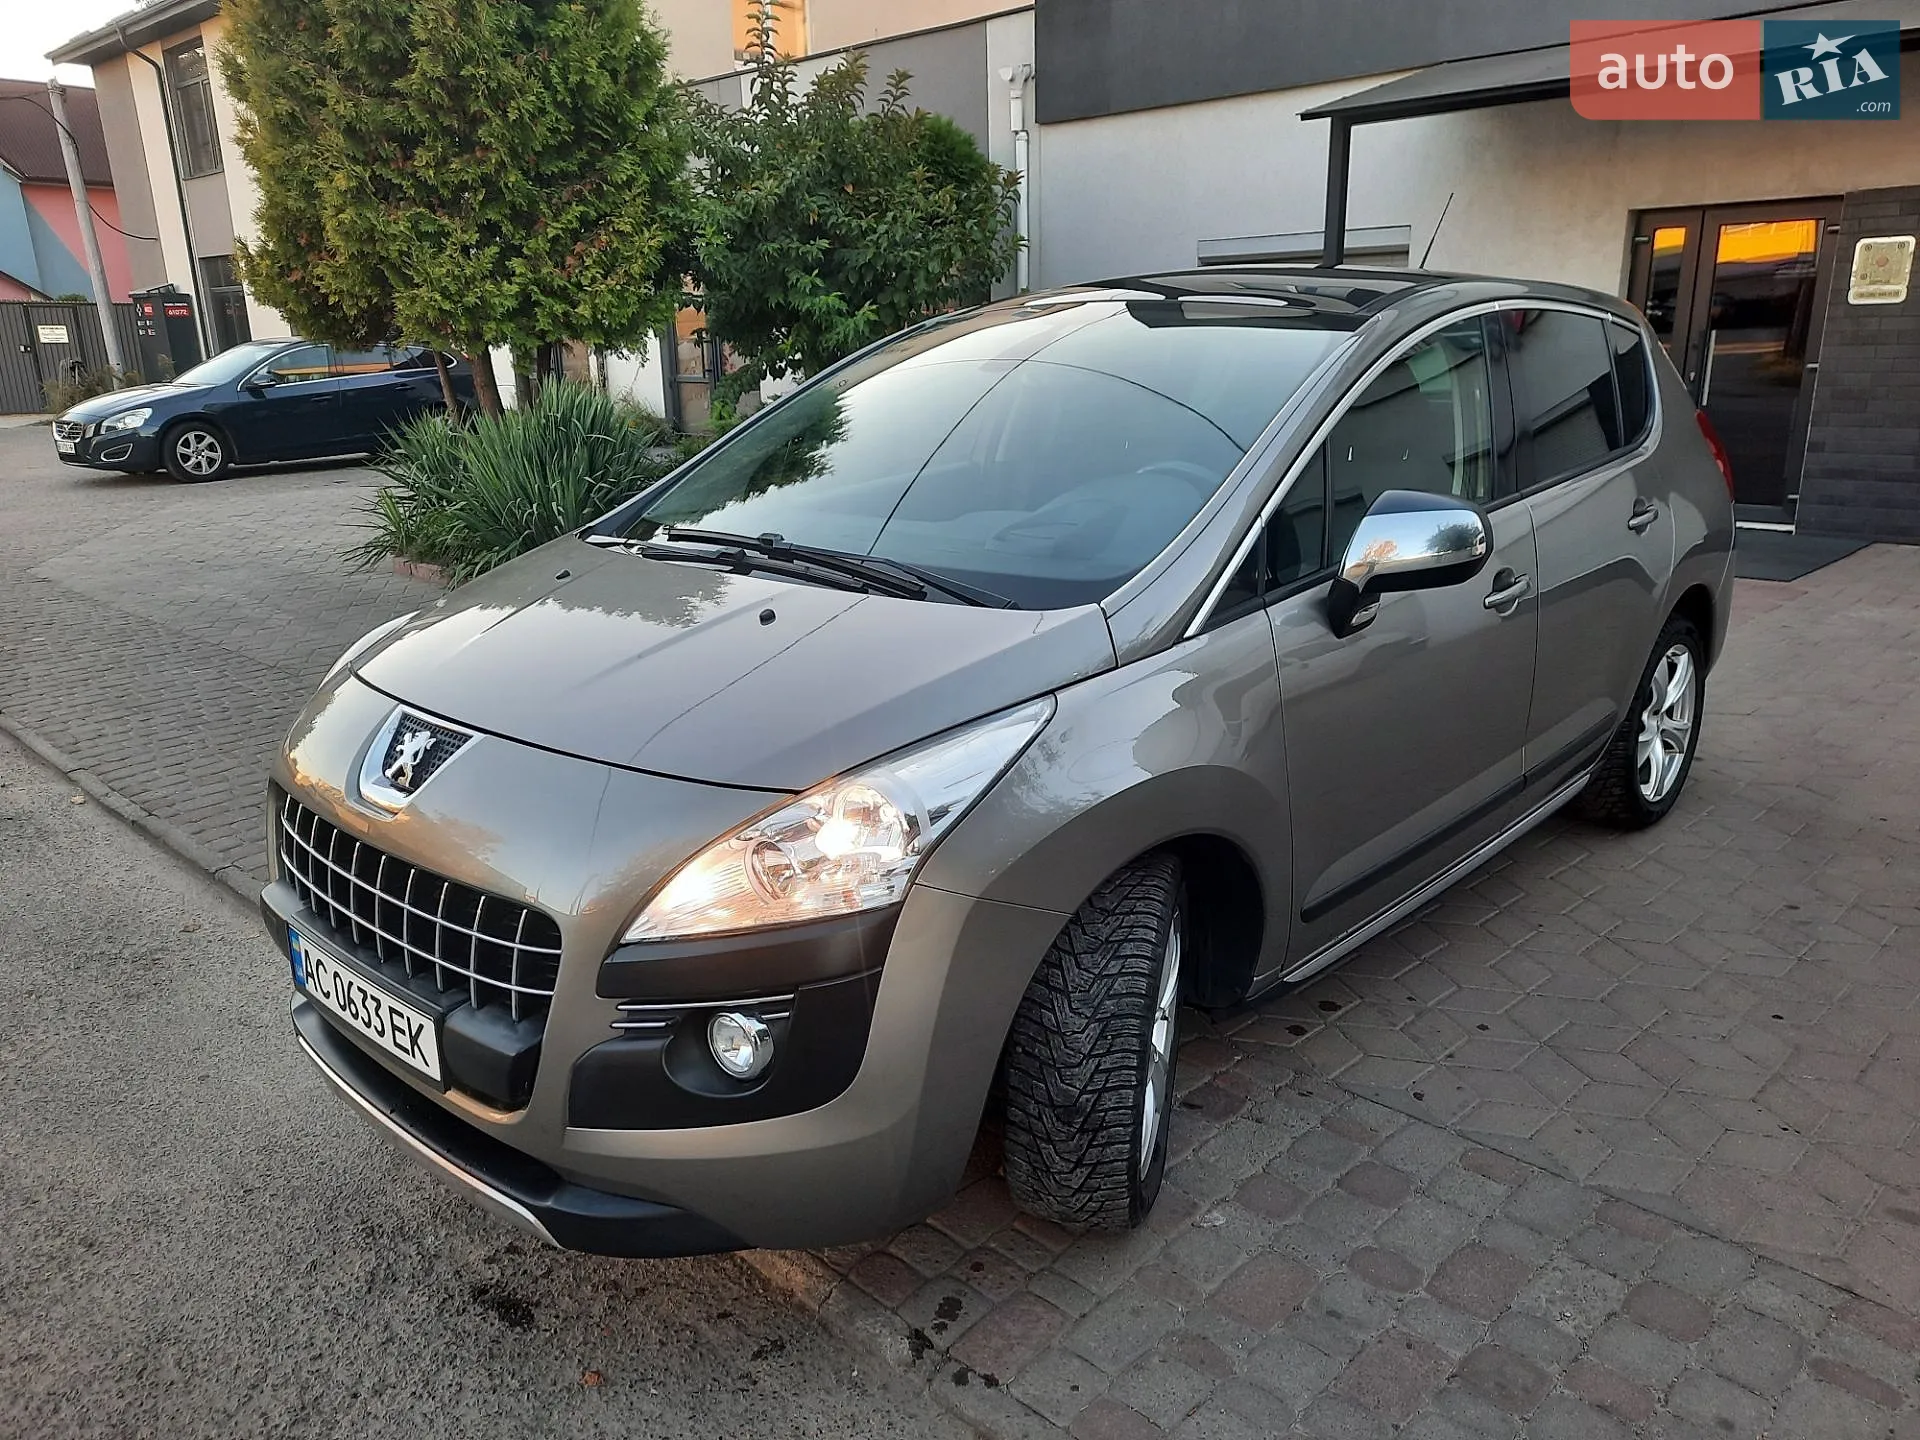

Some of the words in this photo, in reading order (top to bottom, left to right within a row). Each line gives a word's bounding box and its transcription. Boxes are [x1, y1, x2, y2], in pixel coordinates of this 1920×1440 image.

[304, 948, 331, 1000] AC
[333, 970, 386, 1039] 0633
[388, 1005, 430, 1068] EK
